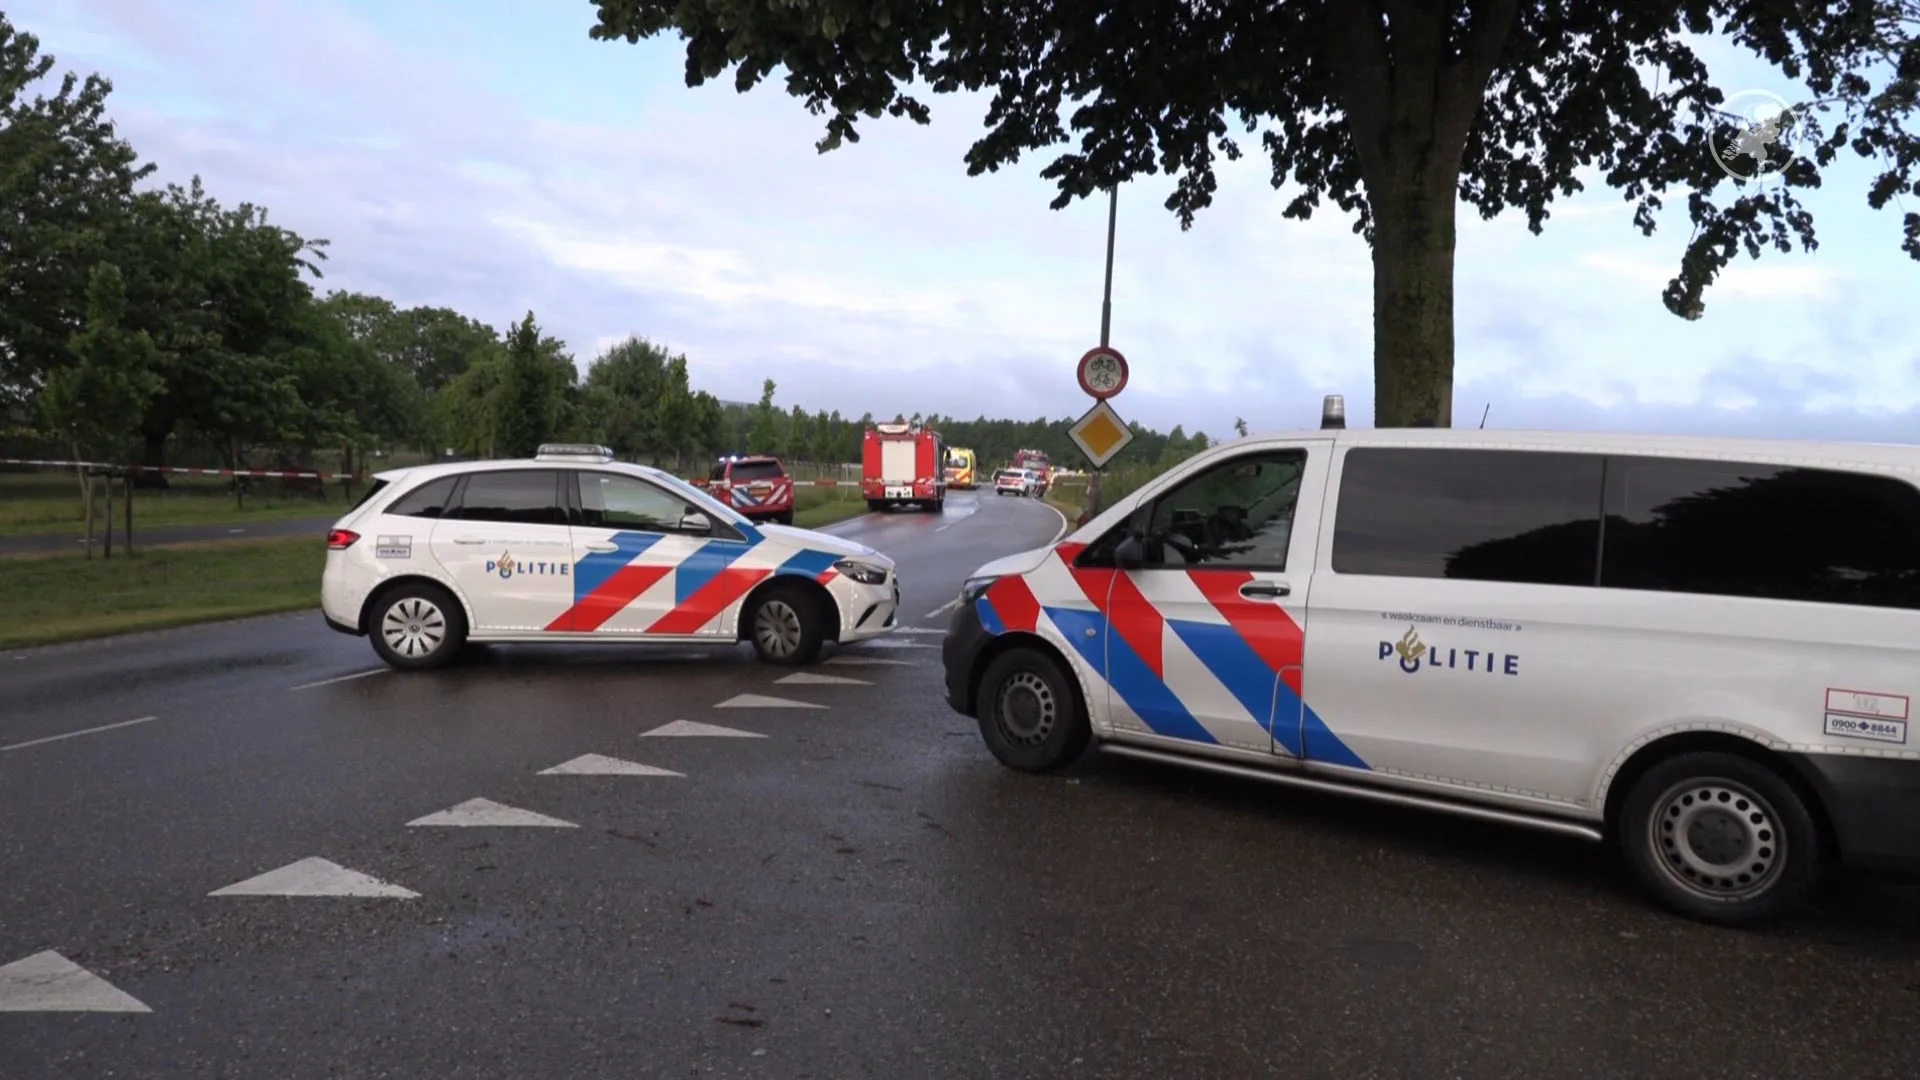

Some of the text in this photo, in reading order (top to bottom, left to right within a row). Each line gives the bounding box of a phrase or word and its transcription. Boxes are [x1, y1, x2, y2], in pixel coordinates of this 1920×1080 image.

[486, 560, 569, 579] POLITIE
[1389, 611, 1442, 624] waakzaam
[1443, 617, 1457, 626] en
[1457, 617, 1513, 631] dienstbaar
[1379, 640, 1520, 676] POLITIE
[1831, 718, 1857, 729] 0900
[1870, 723, 1897, 734] 8844
